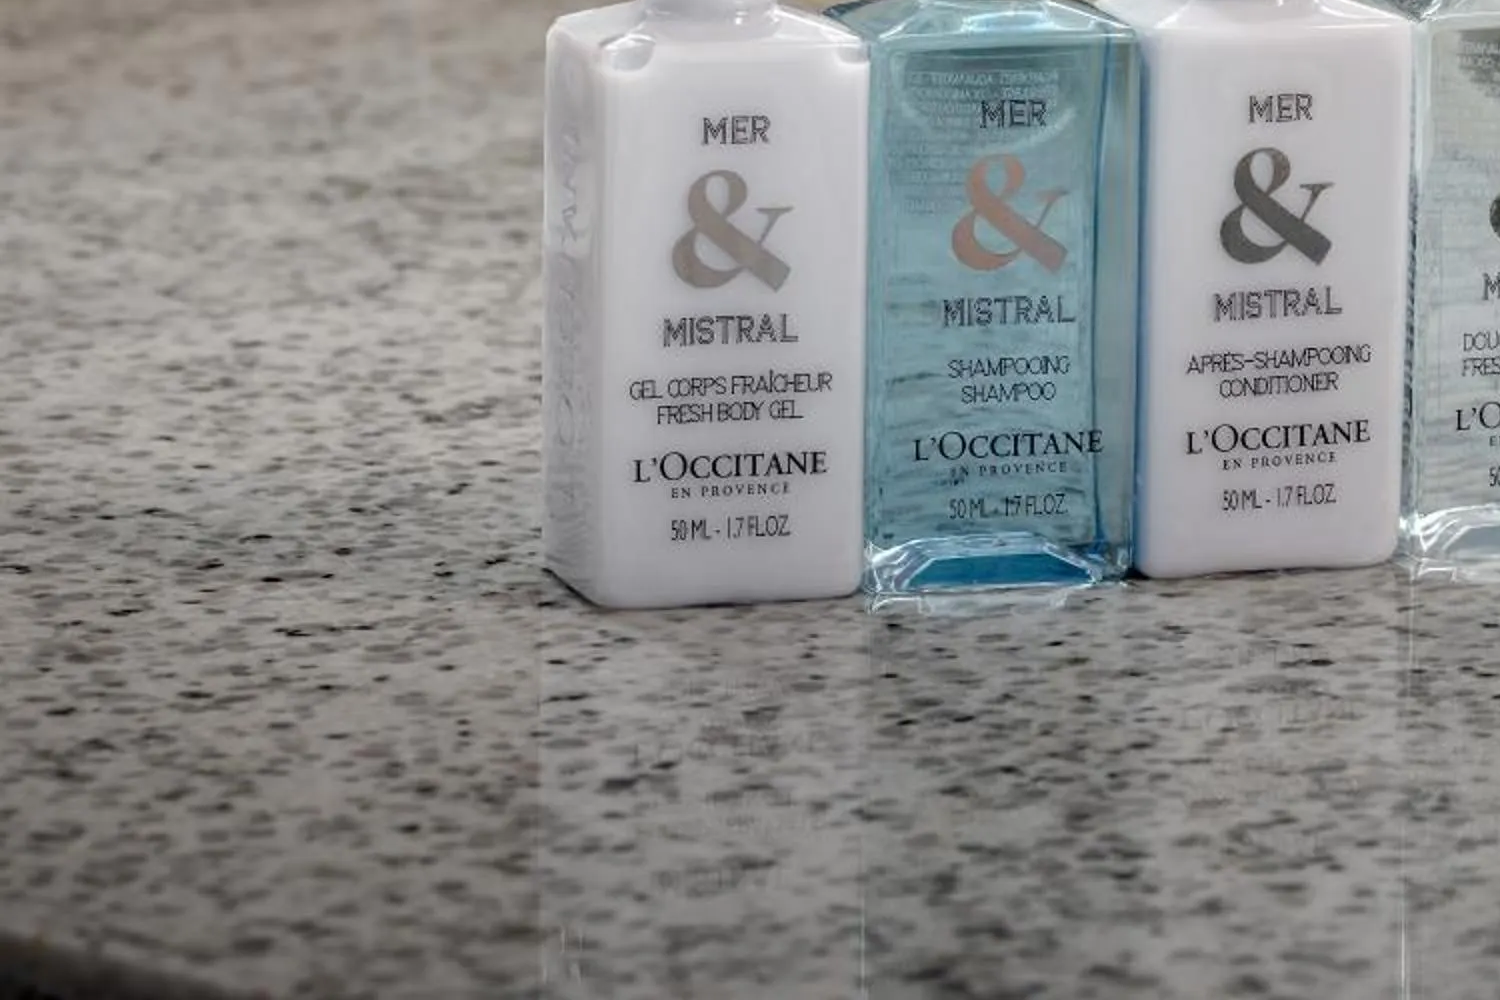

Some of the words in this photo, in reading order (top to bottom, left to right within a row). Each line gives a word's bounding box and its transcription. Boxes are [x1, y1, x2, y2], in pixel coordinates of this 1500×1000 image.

[979, 99, 1047, 128] MER
[1249, 94, 1313, 123] MER
[702, 115, 771, 146] MER
[951, 152, 1070, 275] &
[1219, 147, 1335, 266] &
[671, 169, 795, 293] &
[943, 295, 1076, 327] MISTRAL
[1213, 285, 1343, 322] MISTRAL
[662, 313, 799, 348] MISTRAL
[948, 355, 1071, 379] SHAMPOOING
[629, 379, 663, 400] GEL
[668, 376, 727, 399] CORPS
[961, 381, 1057, 404] SHAMPOO
[1219, 371, 1340, 398] CONDITIONER
[657, 403, 713, 425] FRESH
[717, 401, 764, 422] BODY
[769, 400, 804, 420] GEL
[913, 430, 1105, 462] L'OCCITANE
[1186, 419, 1371, 455] L'OCCITANE
[633, 451, 827, 483] L'OCCITANE
[951, 465, 970, 477] EN
[979, 461, 1067, 476] PROVENCE
[1222, 459, 1242, 471] EN
[1251, 452, 1337, 469] PROVENCE
[671, 487, 691, 499] EN
[701, 482, 790, 497] PROVENCE
[1223, 489, 1239, 511] 50
[1242, 488, 1262, 510] ML
[949, 498, 966, 519] 50
[671, 519, 687, 541] 50
[691, 518, 711, 540] ML
